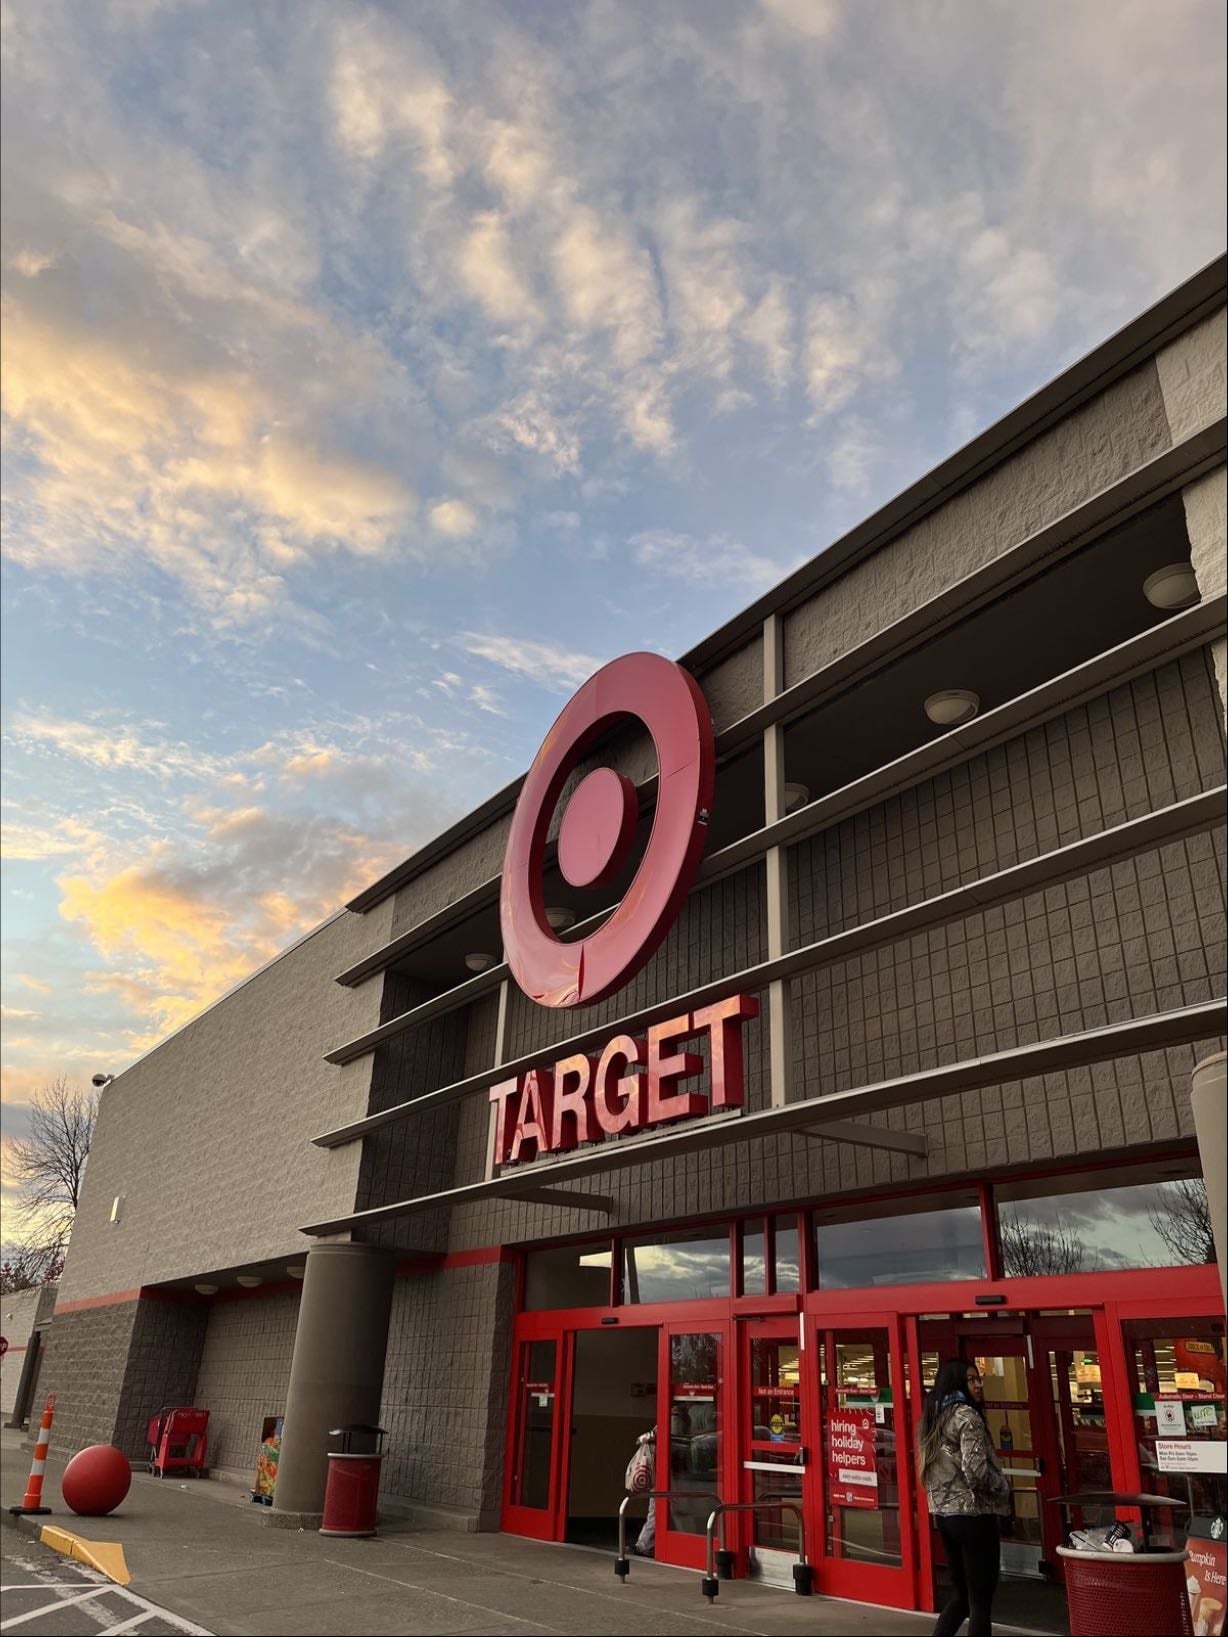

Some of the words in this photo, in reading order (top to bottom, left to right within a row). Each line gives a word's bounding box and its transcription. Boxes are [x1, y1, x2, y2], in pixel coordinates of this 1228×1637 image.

[489, 993, 758, 1165] TARGET
[831, 1419, 857, 1436] hiring
[831, 1434, 865, 1452] holiday
[1158, 1442, 1174, 1450] Store
[832, 1450, 867, 1467] helpers
[1189, 1550, 1216, 1567] Pumpkin
[1204, 1569, 1212, 1582] Is
[1211, 1571, 1227, 1586] Here
